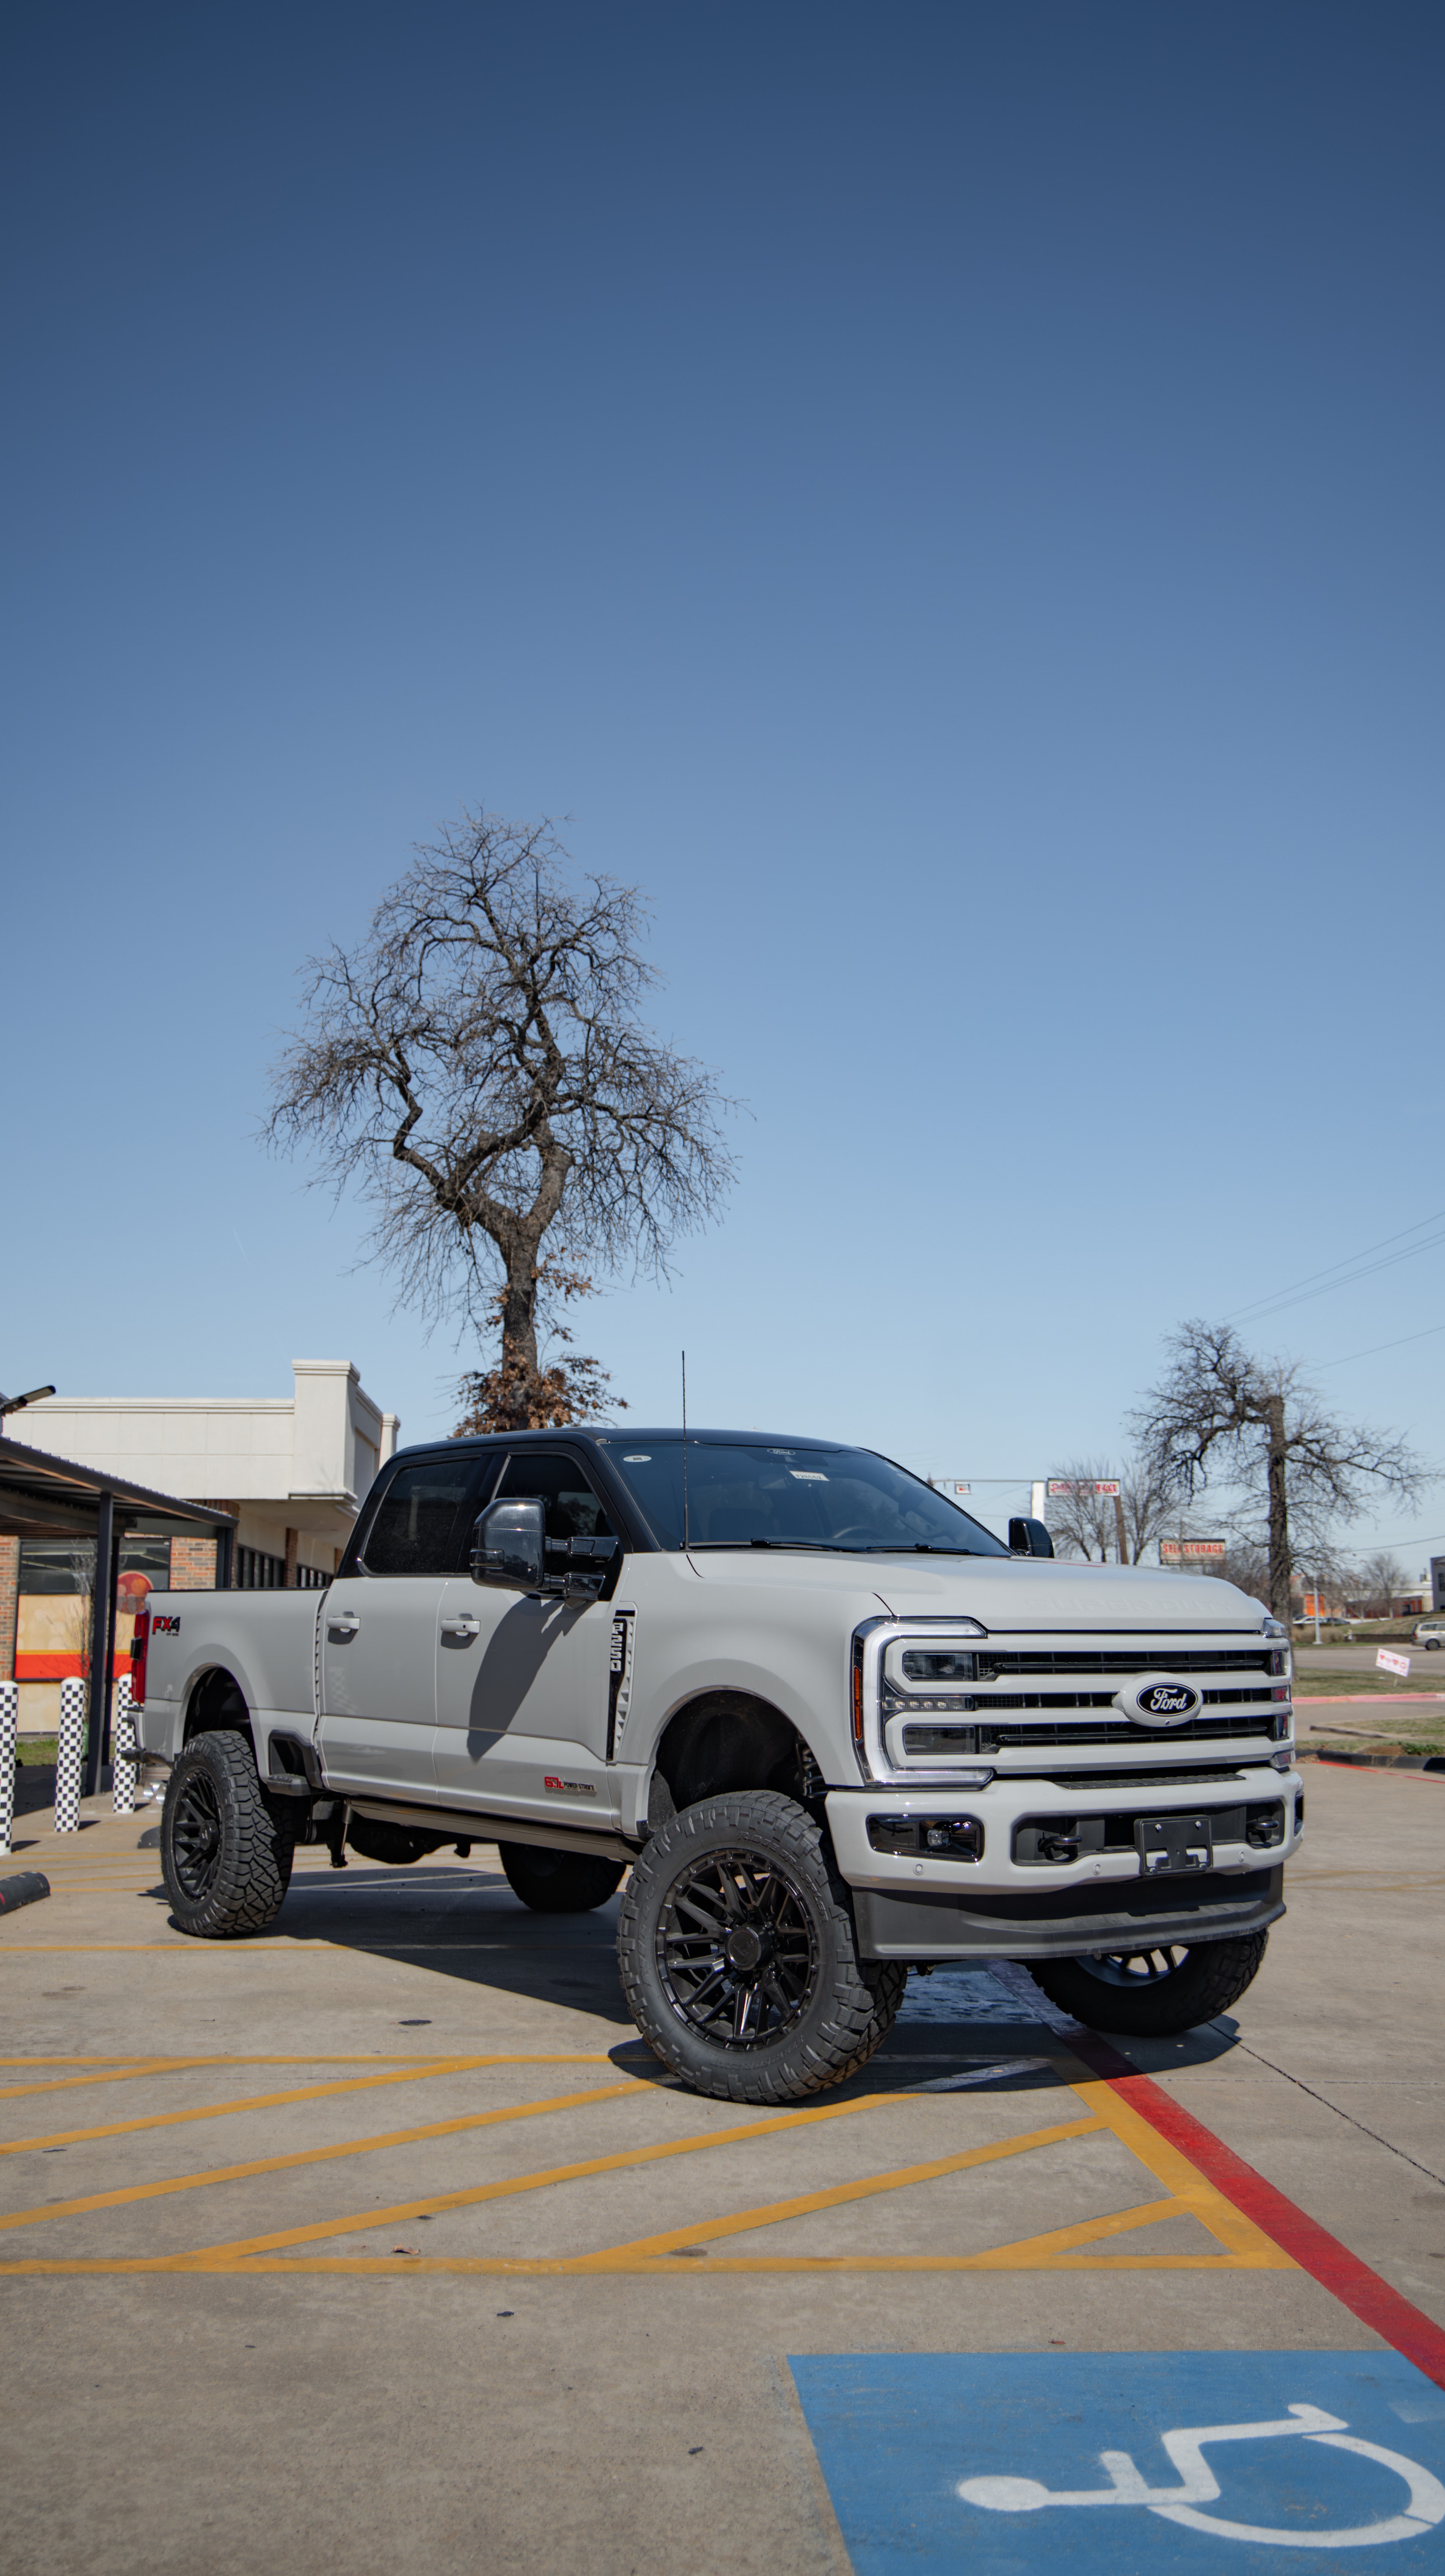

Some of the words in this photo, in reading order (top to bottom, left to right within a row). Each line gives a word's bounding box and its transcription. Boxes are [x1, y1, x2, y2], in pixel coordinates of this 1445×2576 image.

[1183, 1544, 1223, 1554] STORAGE
[1025, 1598, 1156, 1611] SUPER
[1158, 1599, 1234, 1612] DUTY
[152, 1616, 181, 1635] FX4
[1150, 1687, 1188, 1711] Ford
[544, 1776, 564, 1789] 6.7L
[737, 1831, 780, 1852] RIDGE
[778, 1848, 829, 1922] GRAPPLER
